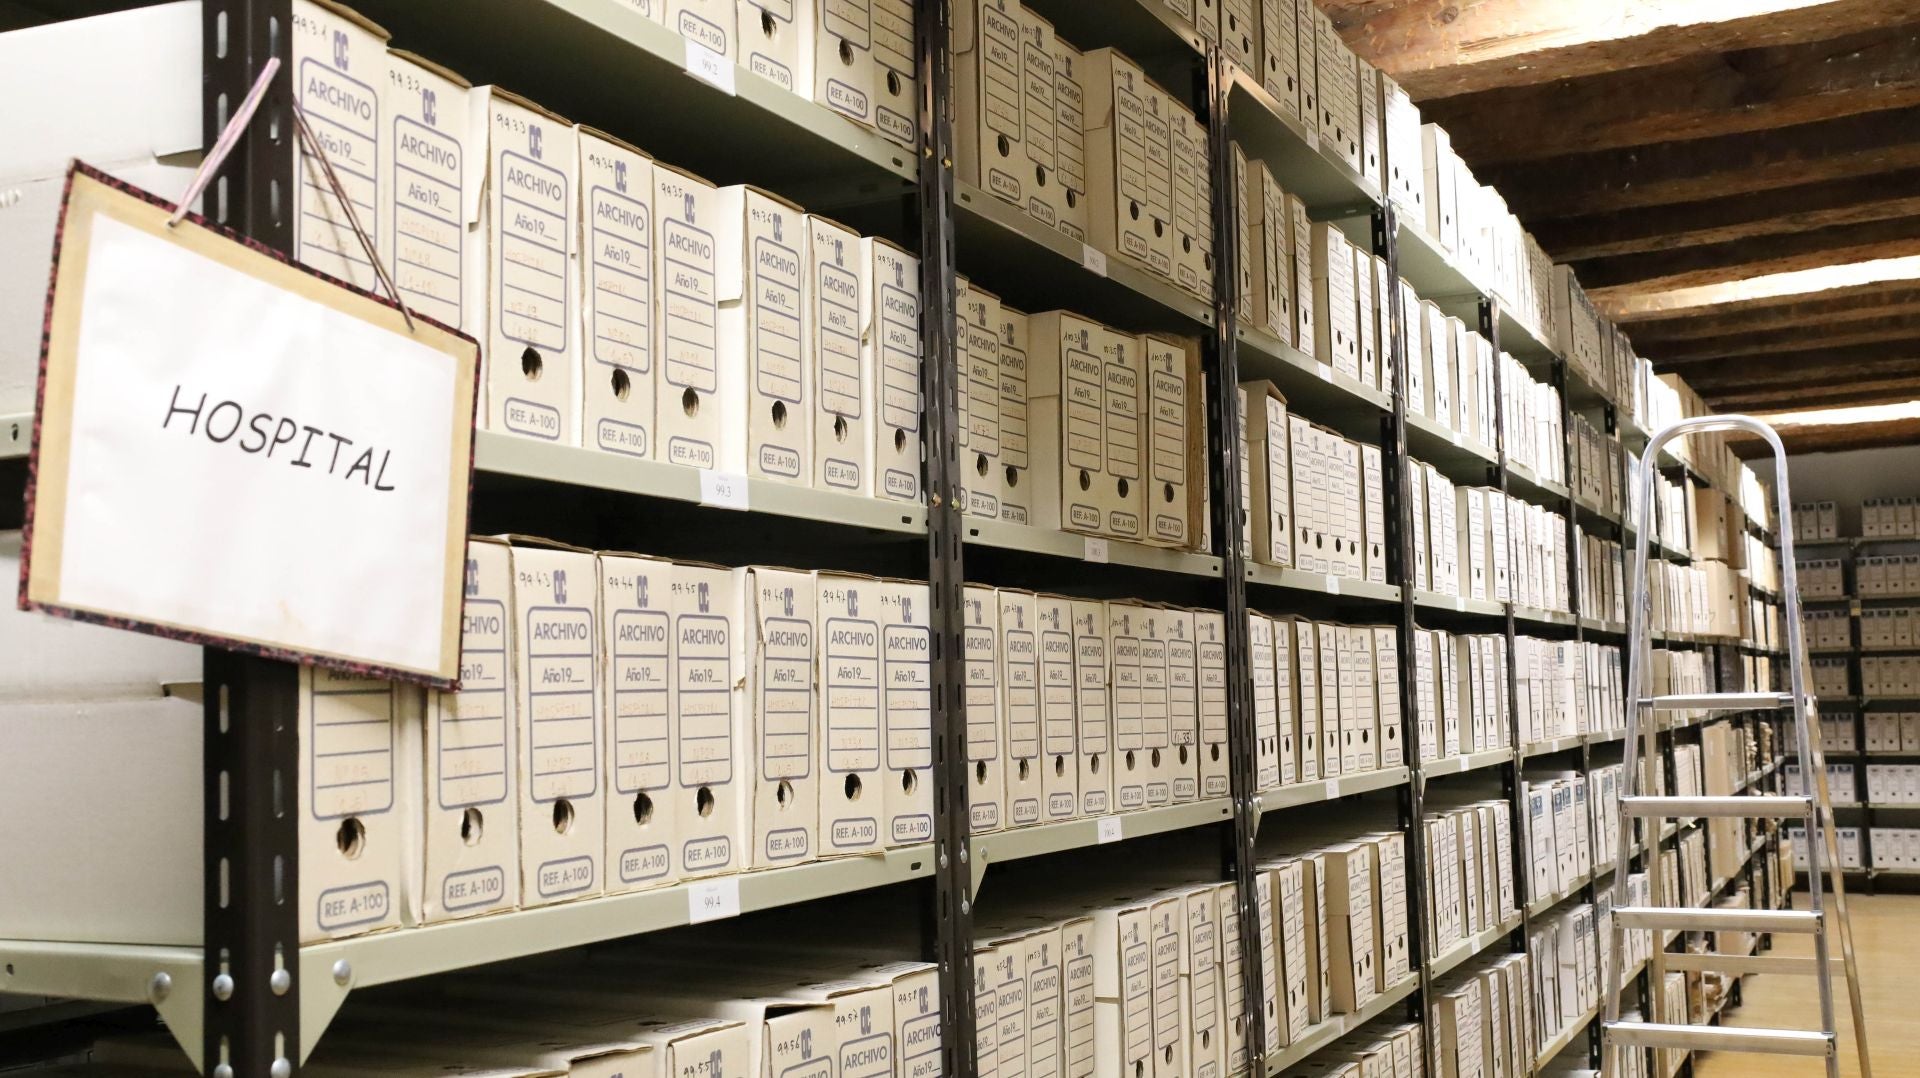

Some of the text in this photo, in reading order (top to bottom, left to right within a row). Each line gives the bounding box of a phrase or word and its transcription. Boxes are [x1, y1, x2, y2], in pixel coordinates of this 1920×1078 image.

[684, 19, 722, 46] REF. A-100
[987, 16, 1015, 40] ARCHIVO
[754, 60, 788, 85] REF. A-100
[308, 78, 371, 120] ARCHIVO
[831, 86, 864, 110] REF. A-100
[880, 112, 910, 136] REF. A-100
[401, 133, 456, 171] ARCHIVO
[507, 167, 562, 201] ARCHIVO
[597, 201, 644, 231] ARCHIVO
[668, 232, 710, 259] ARCHIVO
[760, 250, 796, 277] ARCHIVO
[823, 275, 855, 298] ARCHIVO
[885, 296, 915, 317] ARCHIVO
[969, 334, 996, 353] ARCHIVO
[1070, 358, 1099, 376] ARCHIVO
[1108, 371, 1134, 388] ARCHIVO
[1156, 380, 1181, 396] ARCHIVO
[510, 408, 555, 430] REF. A-100
[163, 385, 395, 491] HOSPITAL
[602, 428, 642, 447] REF. A-100
[673, 445, 710, 462] REF. A-100
[763, 453, 796, 469] REF. A-100
[828, 466, 856, 481] REF. A-100
[715, 484, 731, 498] 99.3
[888, 477, 913, 491] REF. A-100
[464, 615, 500, 635] CHIVO
[534, 622, 587, 641] ARCHIVO
[619, 624, 664, 642] ARCHIVO
[682, 629, 725, 645] ARCHIVO
[769, 631, 808, 647] ARCHIVO
[832, 631, 874, 646] ARCHIVO
[888, 637, 926, 650] ARCHIVO
[966, 638, 991, 650] ARCHIVO
[836, 826, 873, 839] REF. A-100
[896, 821, 928, 834] REF. A-100
[770, 835, 804, 850] REF. A-100
[624, 854, 665, 872] REF. A-100
[688, 846, 726, 862] REF. A-100
[544, 867, 588, 887] REF. A-100
[449, 877, 498, 899] REF. A-100
[325, 892, 382, 919] REF. A-100
[705, 896, 720, 908] 99.4
[845, 1046, 887, 1070] ARCHIVO
